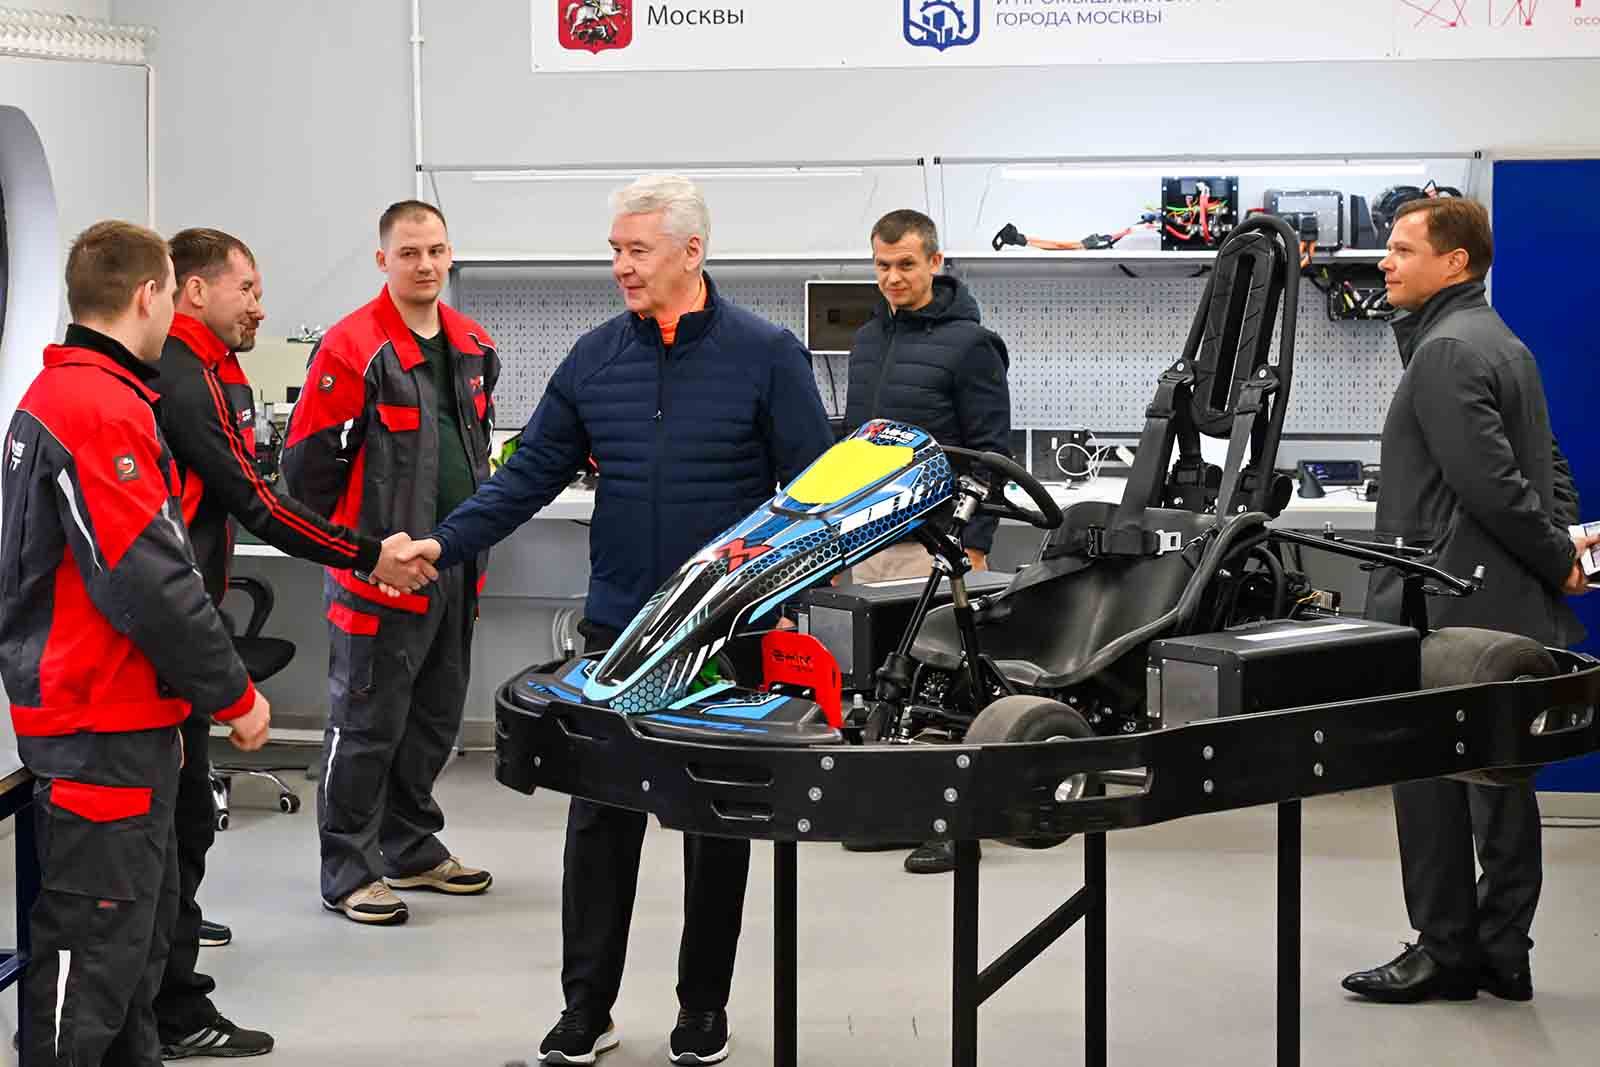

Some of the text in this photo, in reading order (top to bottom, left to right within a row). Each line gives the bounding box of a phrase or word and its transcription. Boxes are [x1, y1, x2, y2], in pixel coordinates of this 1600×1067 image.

[647, 4, 744, 25] Москвы
[996, 9, 1162, 27] ГОРОДА МОСКВЫ
